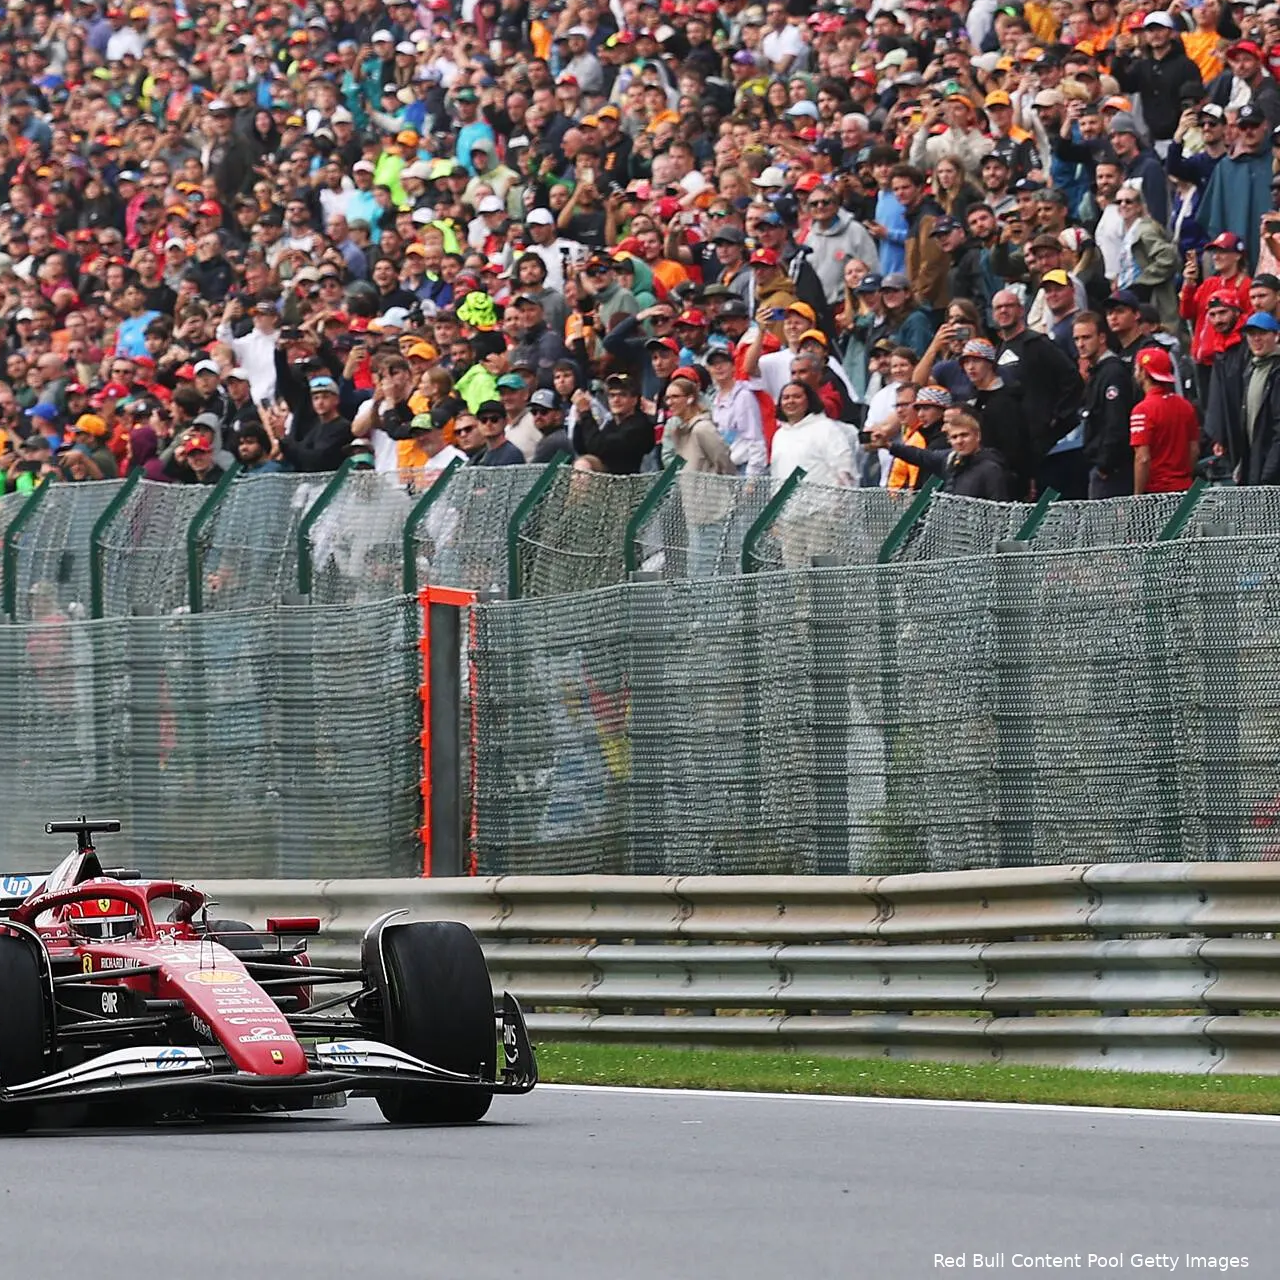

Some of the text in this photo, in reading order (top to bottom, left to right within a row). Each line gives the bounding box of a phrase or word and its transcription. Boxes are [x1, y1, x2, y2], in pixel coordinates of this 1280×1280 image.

[7, 876, 30, 896] hp
[44, 887, 83, 900] TECHNOLOGY
[101, 958, 123, 969] RICHARD
